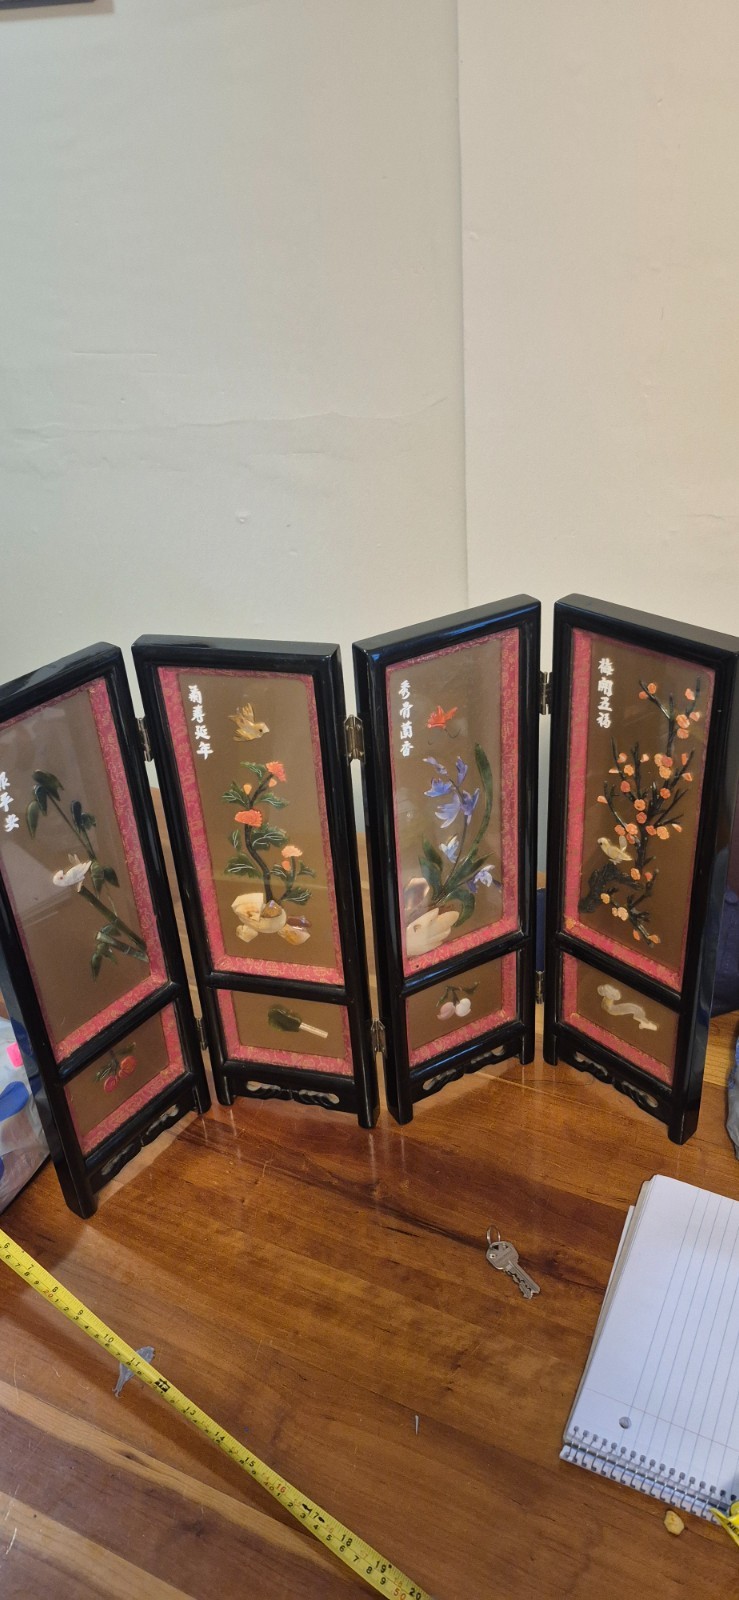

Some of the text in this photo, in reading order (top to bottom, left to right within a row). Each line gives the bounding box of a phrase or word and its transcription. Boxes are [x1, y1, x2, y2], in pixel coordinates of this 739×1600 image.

[104, 1333, 115, 1343] 10
[244, 1456, 256, 1467] 15
[276, 1483, 287, 1494] 16
[341, 1534, 353, 1547] 18
[375, 1560, 387, 1574] 19
[409, 1587, 422, 1600] 20
[366, 1565, 373, 1574] 8
[380, 1576, 387, 1585] 9
